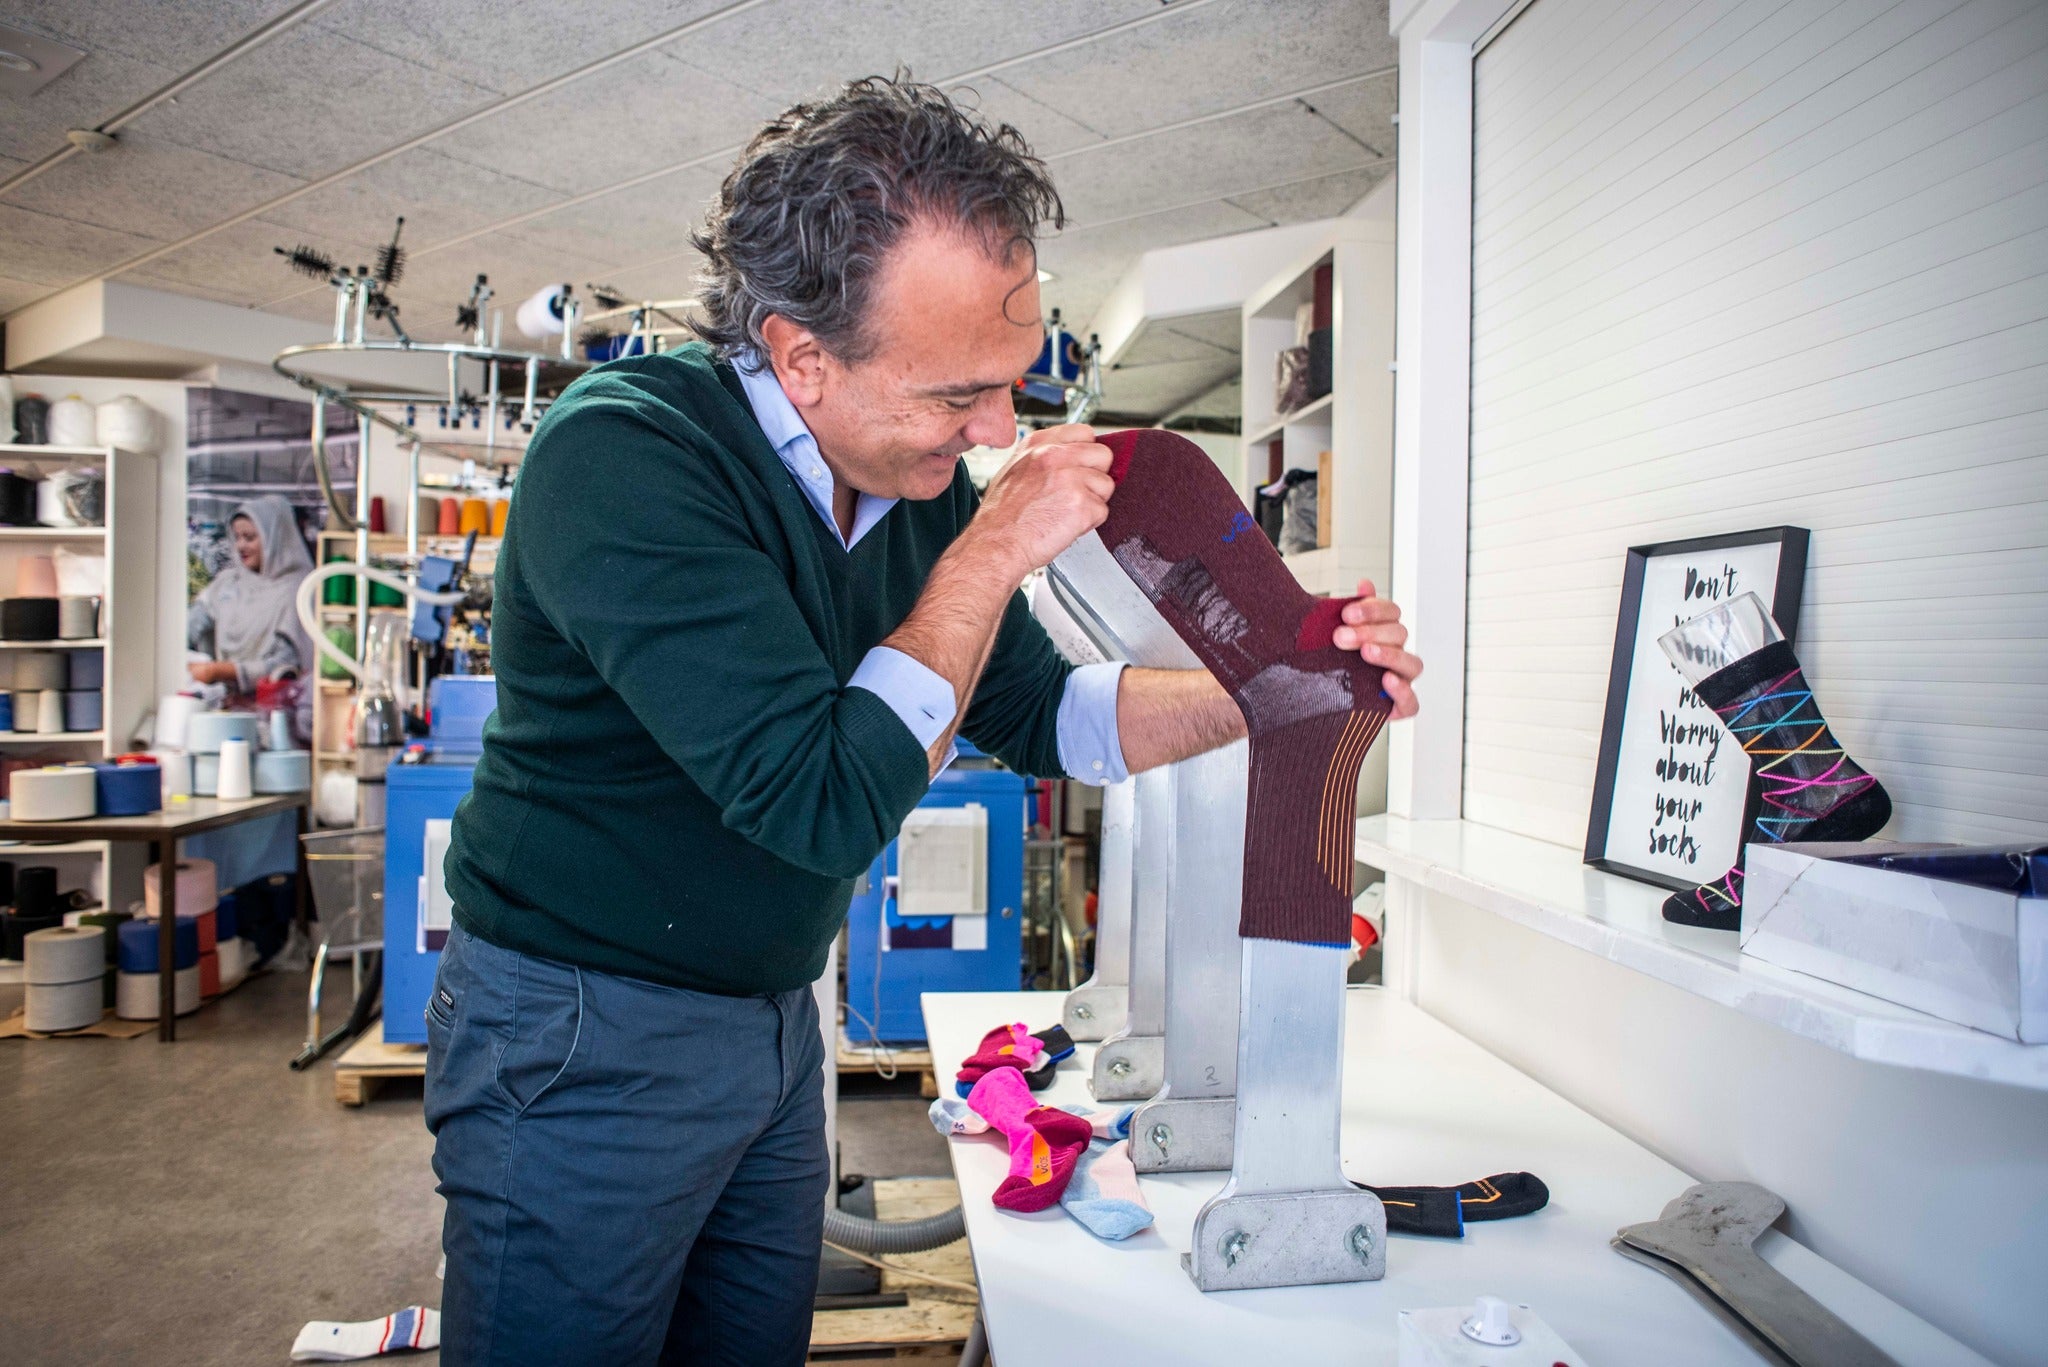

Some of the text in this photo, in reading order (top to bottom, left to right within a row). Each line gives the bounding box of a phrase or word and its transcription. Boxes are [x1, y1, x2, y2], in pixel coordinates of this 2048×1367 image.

[1684, 563, 1739, 601] Don't
[1660, 709, 1725, 760] Worry
[1655, 746, 1716, 787] about
[1655, 793, 1702, 827] your
[1649, 825, 1702, 865] socks
[1205, 1065, 1219, 1082] 2
